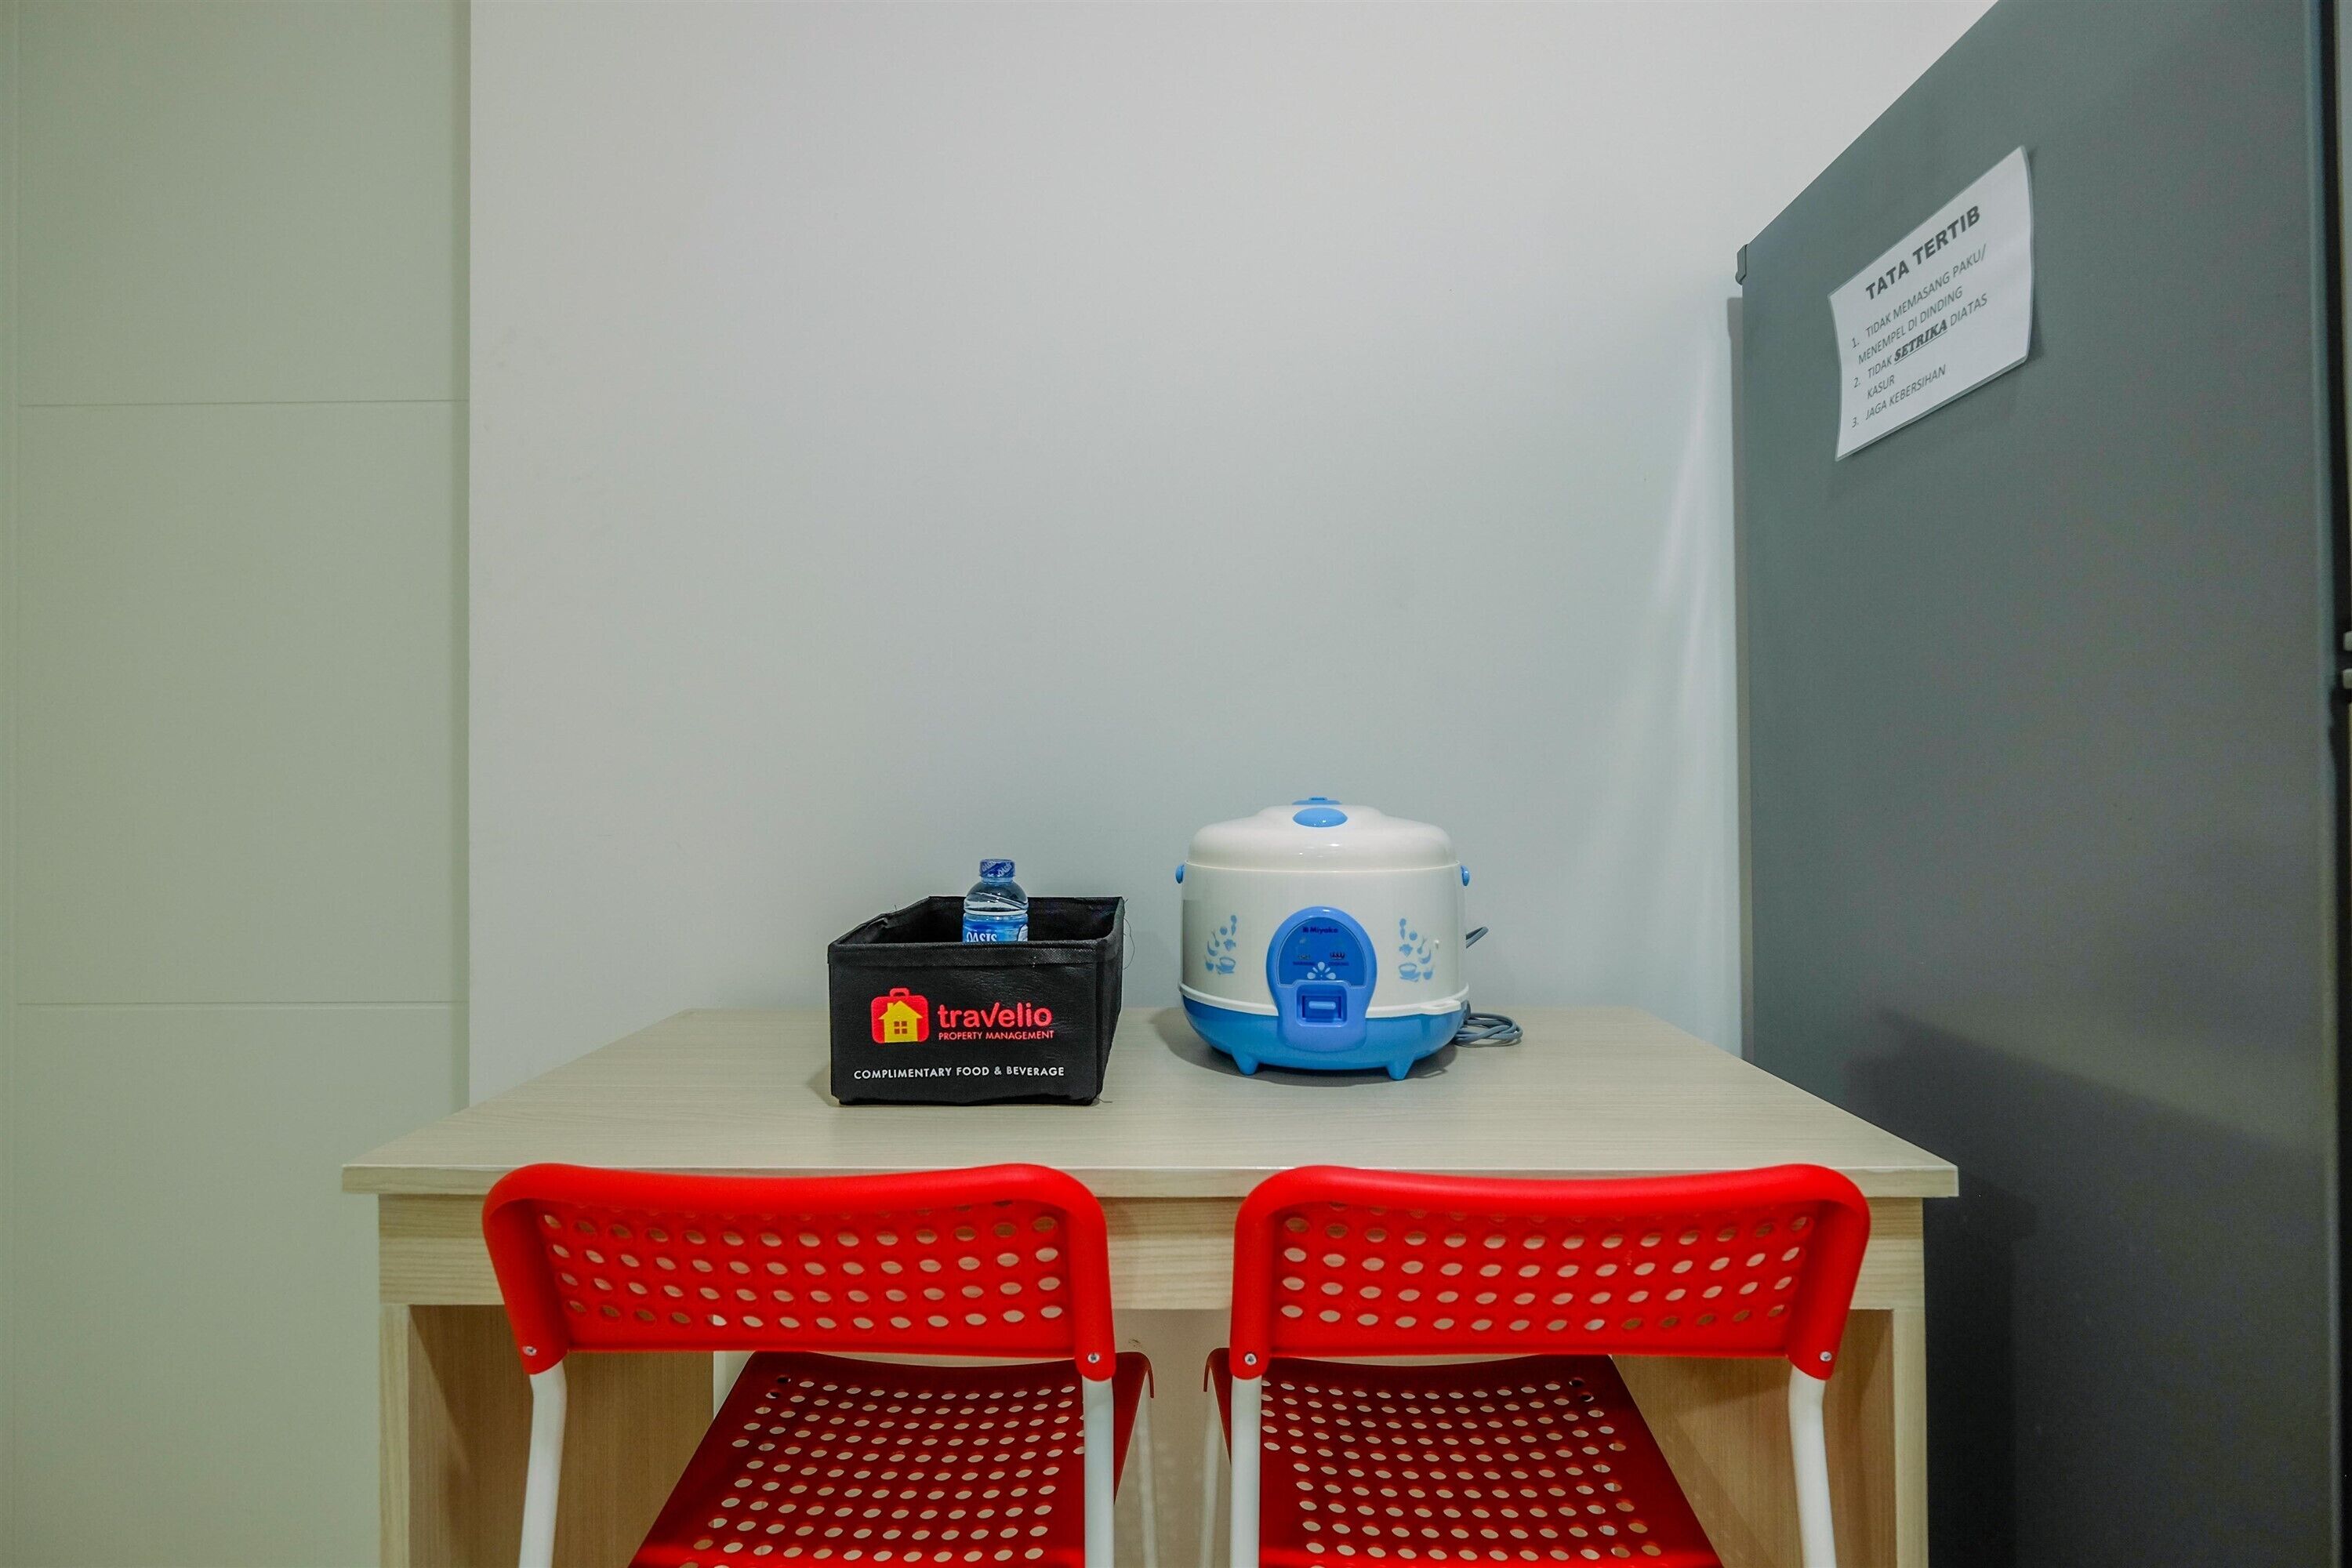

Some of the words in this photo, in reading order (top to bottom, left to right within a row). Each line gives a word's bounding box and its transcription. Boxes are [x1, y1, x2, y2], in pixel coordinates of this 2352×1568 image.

[1865, 260, 1909, 300] TATA
[1913, 205, 1980, 266] TERTIB
[1851, 337, 1860, 349] 1.
[1865, 312, 1892, 338] TIDAK
[1893, 271, 1951, 320] MEMASANG
[1952, 244, 1987, 277] PAKU/
[1853, 377, 1860, 388] 2.
[1867, 355, 1893, 379] TIDAK
[1893, 319, 1948, 363] SETRIKA
[1950, 293, 1988, 327] DIATAS
[1858, 325, 1907, 365] MENEMPEL
[1907, 319, 1918, 333] DI
[1920, 286, 1963, 326] DINDING
[1851, 416, 1859, 428] 3.
[1865, 400, 1887, 421] JAGA
[1888, 364, 1947, 408] KEBERSIHAN
[1867, 375, 1895, 399] KASUR
[966, 932, 997, 942] OASIS
[938, 1002, 1053, 1028] travelio
[938, 1031, 983, 1040] PROPERTY
[985, 1030, 1054, 1040] MANAGEMENT
[854, 1067, 952, 1080] COMPLIMENTARY
[956, 1066, 989, 1077] FOOD
[994, 1066, 1002, 1076] &
[1006, 1066, 1065, 1076] BEVERAGE
